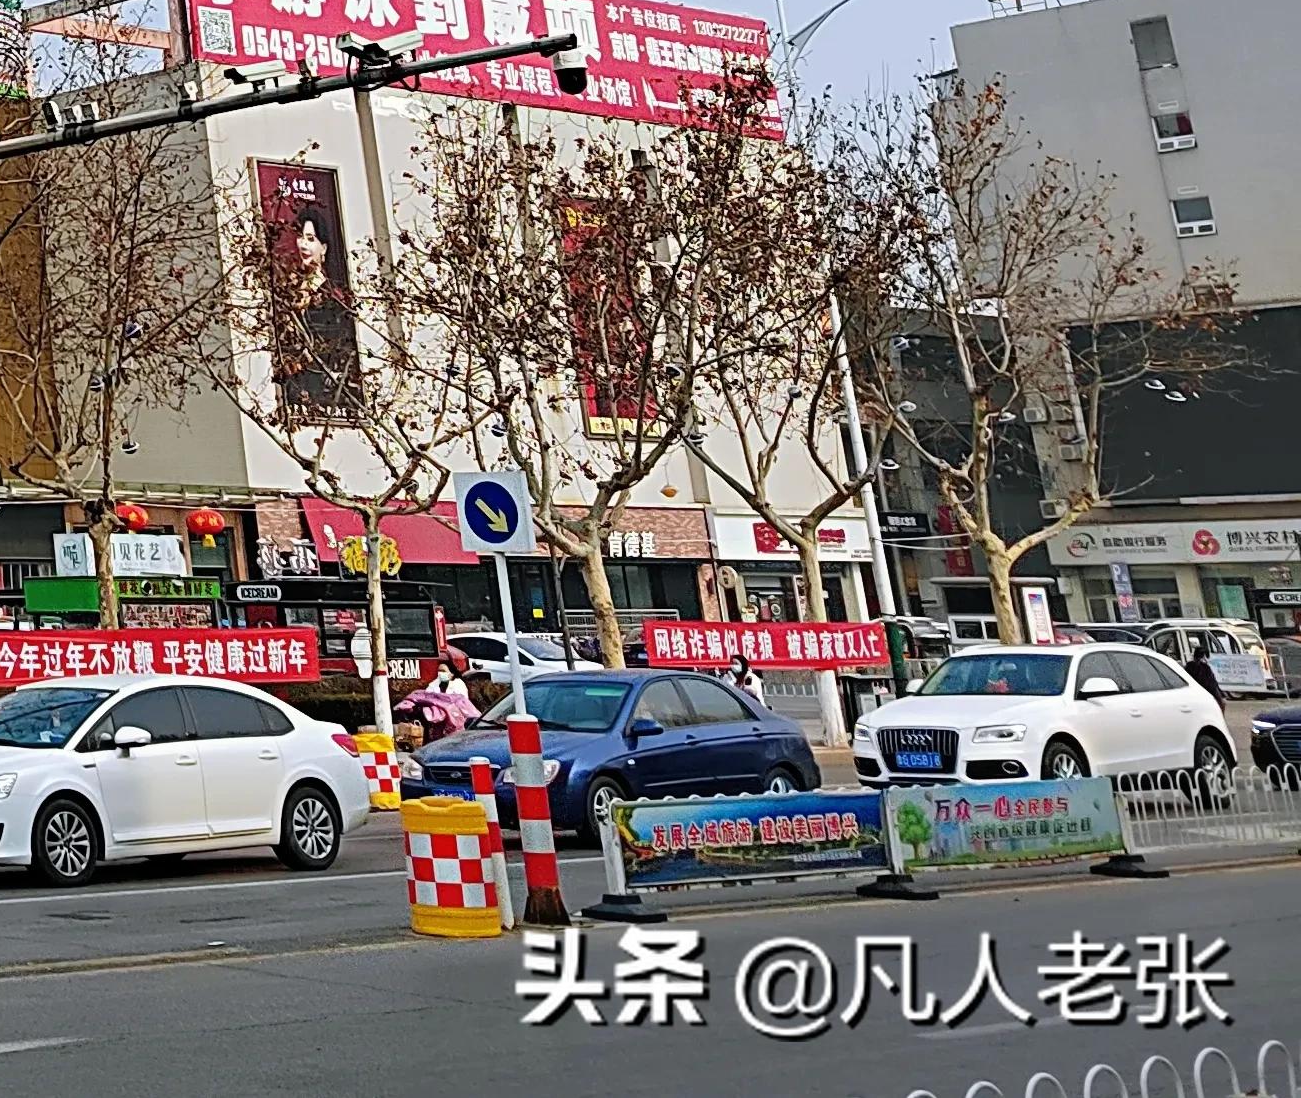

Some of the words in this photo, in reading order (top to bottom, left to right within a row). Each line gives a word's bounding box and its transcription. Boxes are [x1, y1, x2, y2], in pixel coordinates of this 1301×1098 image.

[111, 543, 160, 562] 见花艺
[608, 530, 656, 558] 肯德基
[163, 638, 308, 675] 平安健康过新年
[653, 628, 774, 659] 网络诈骗似虎狼
[652, 818, 754, 852] 发展全域旅游
[759, 812, 860, 845] 建设美丽博兴
